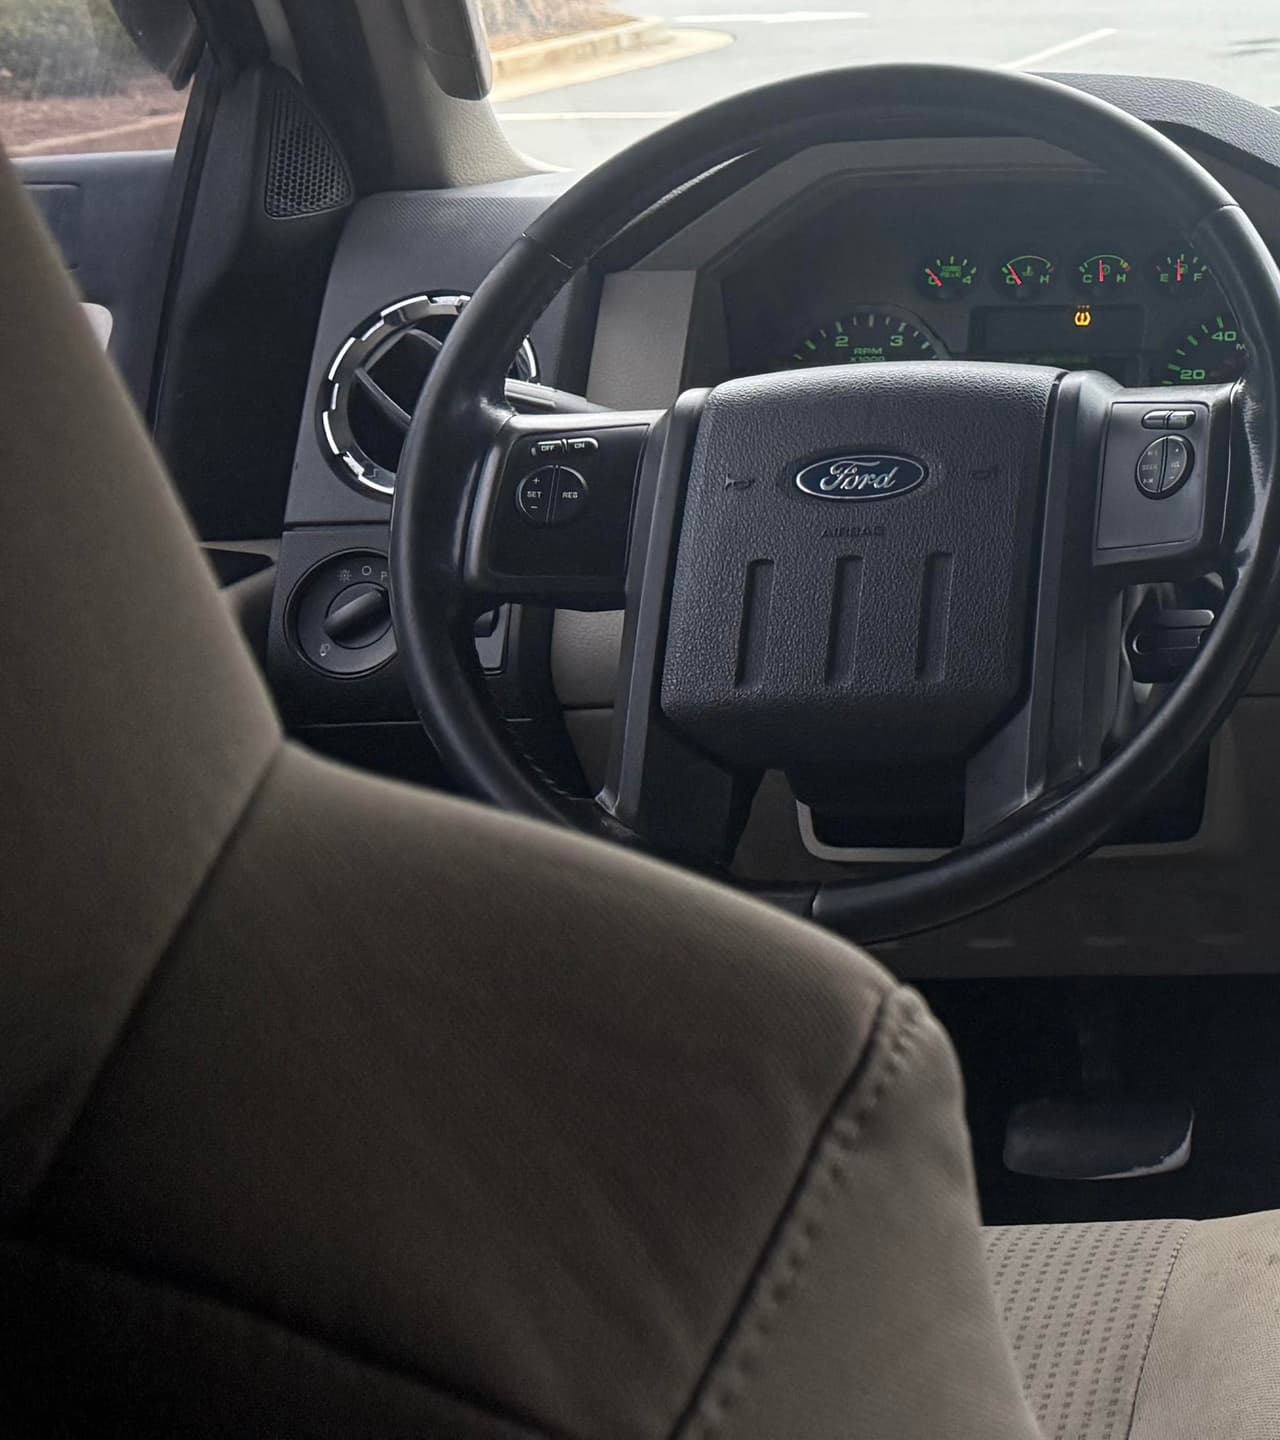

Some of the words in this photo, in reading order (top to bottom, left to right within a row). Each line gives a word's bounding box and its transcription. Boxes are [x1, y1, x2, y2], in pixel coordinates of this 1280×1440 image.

[962, 275, 972, 285] 4
[1040, 274, 1050, 284] H
[1116, 273, 1127, 283] H
[1193, 272, 1203, 281] F
[834, 335, 849, 347] 2
[889, 335, 904, 347] 3
[1211, 330, 1237, 342] 40
[853, 347, 883, 355] RPM
[1180, 369, 1206, 380] 20
[540, 444, 556, 452] OFF
[820, 460, 899, 491] Ford
[527, 490, 542, 498] SET
